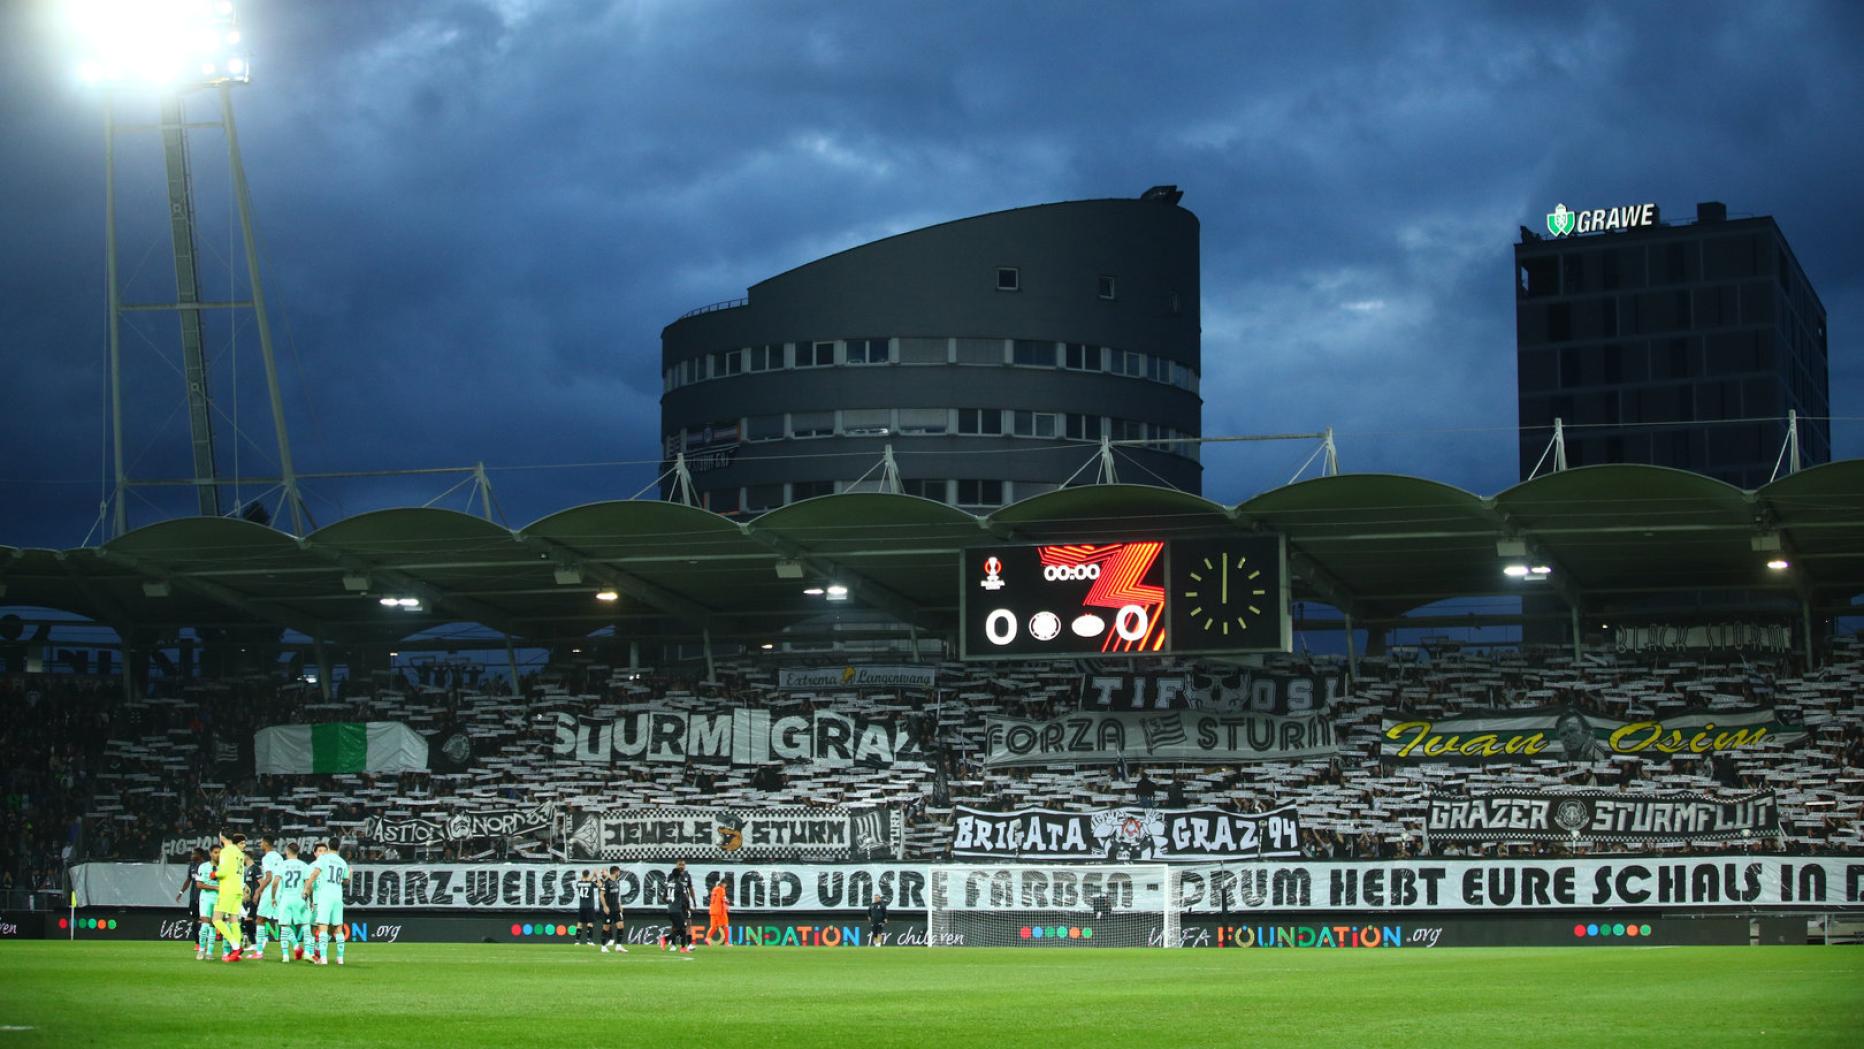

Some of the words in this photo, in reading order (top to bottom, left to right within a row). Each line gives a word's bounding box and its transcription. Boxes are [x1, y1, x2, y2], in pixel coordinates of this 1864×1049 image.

[1577, 203, 1655, 233] GRAWE
[1044, 564, 1100, 581] 00:00
[985, 608, 1018, 646] 0
[1115, 604, 1149, 641] 0
[552, 711, 731, 760] STURM
[986, 717, 1126, 757] FORZA
[1385, 720, 1549, 759] Ivan
[1428, 801, 1549, 831] GRAZER
[1591, 798, 1774, 834] STURMFLUT
[605, 821, 713, 847] JEWELS
[752, 820, 846, 845] STURM
[954, 816, 1087, 851] BRIGATA
[1172, 816, 1259, 852] GRAZ
[284, 870, 302, 888] 27
[327, 865, 343, 885] 18
[703, 870, 803, 908] SIND
[965, 870, 1134, 908] FARBEN
[1171, 868, 1312, 907] DRUM
[1330, 867, 1446, 906] HEBT
[1461, 867, 1576, 906] EURE
[1592, 863, 1763, 905] SCHALS
[1781, 863, 1828, 902] IN
[370, 924, 402, 943] .org
[691, 925, 859, 947] FOUNDATION
[1217, 924, 1401, 948] FOUNDATION
[1406, 926, 1443, 948] .org
